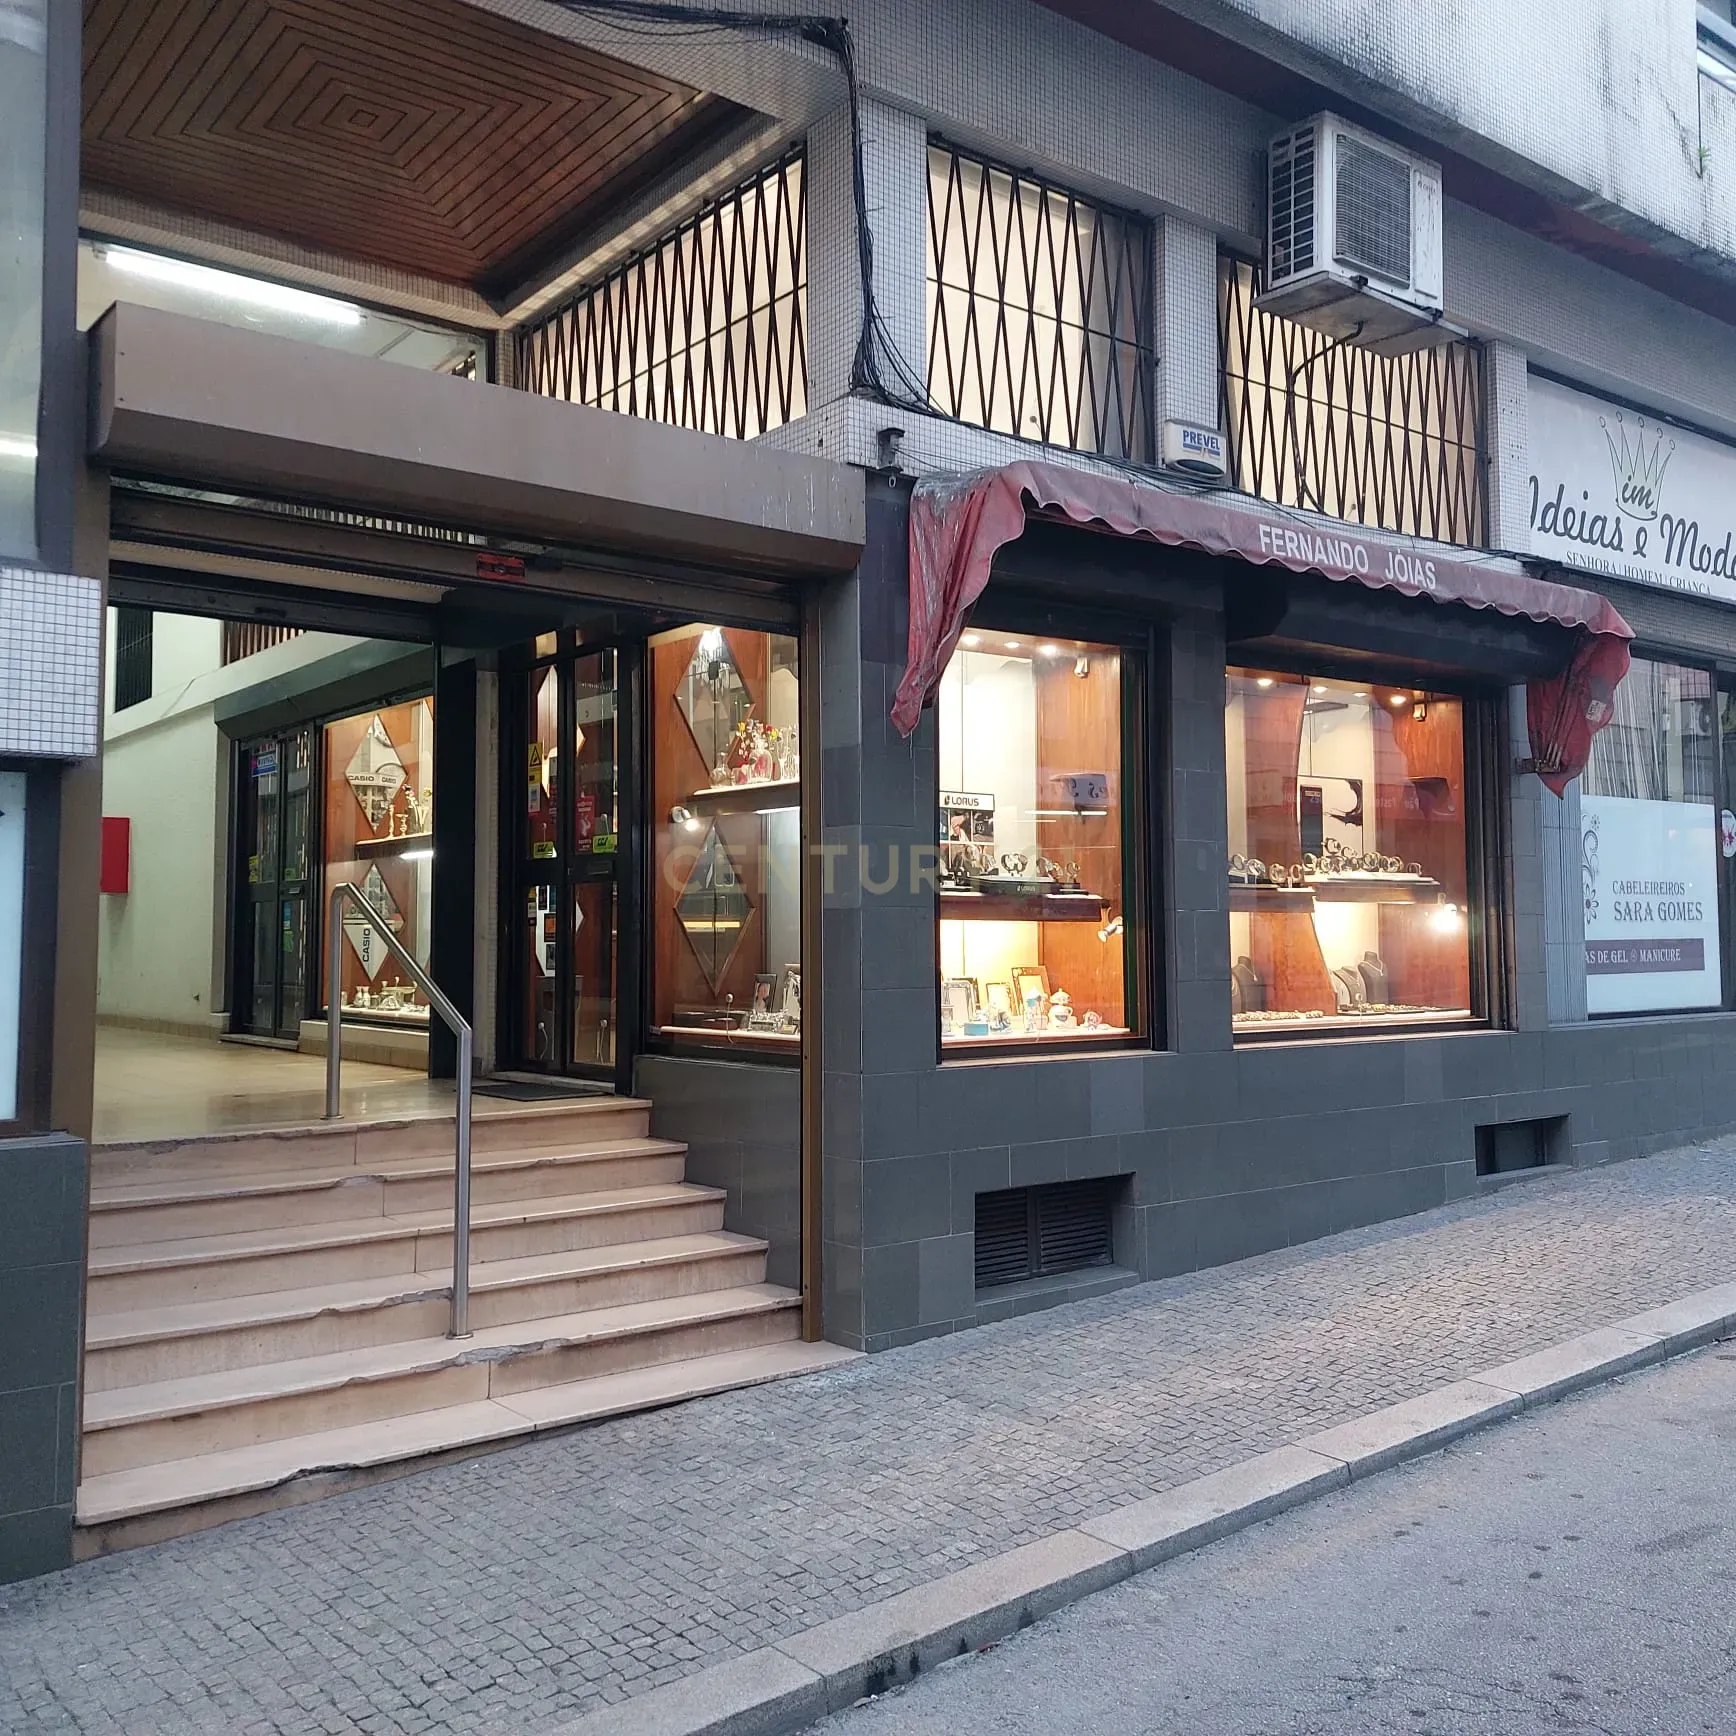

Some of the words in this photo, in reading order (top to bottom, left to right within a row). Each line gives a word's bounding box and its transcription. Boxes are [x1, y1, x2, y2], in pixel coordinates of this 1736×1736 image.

[1183, 430, 1220, 450] PREVEL
[1529, 474, 1624, 553] Ideias
[1633, 526, 1647, 559] e
[1258, 523, 1369, 573] FERNANDO
[1566, 551, 1617, 574] SENHORA
[1624, 564, 1663, 585] HOMEM
[951, 796, 979, 807] LORUS
[1612, 880, 1686, 896] CABELEIREIROS
[1614, 901, 1654, 922] SARA
[1657, 901, 1703, 921] GOMES
[362, 928, 371, 963] CASIO
[1597, 950, 1609, 963] DE
[1610, 949, 1629, 963] GEL
[1639, 948, 1681, 962] MANICURE
